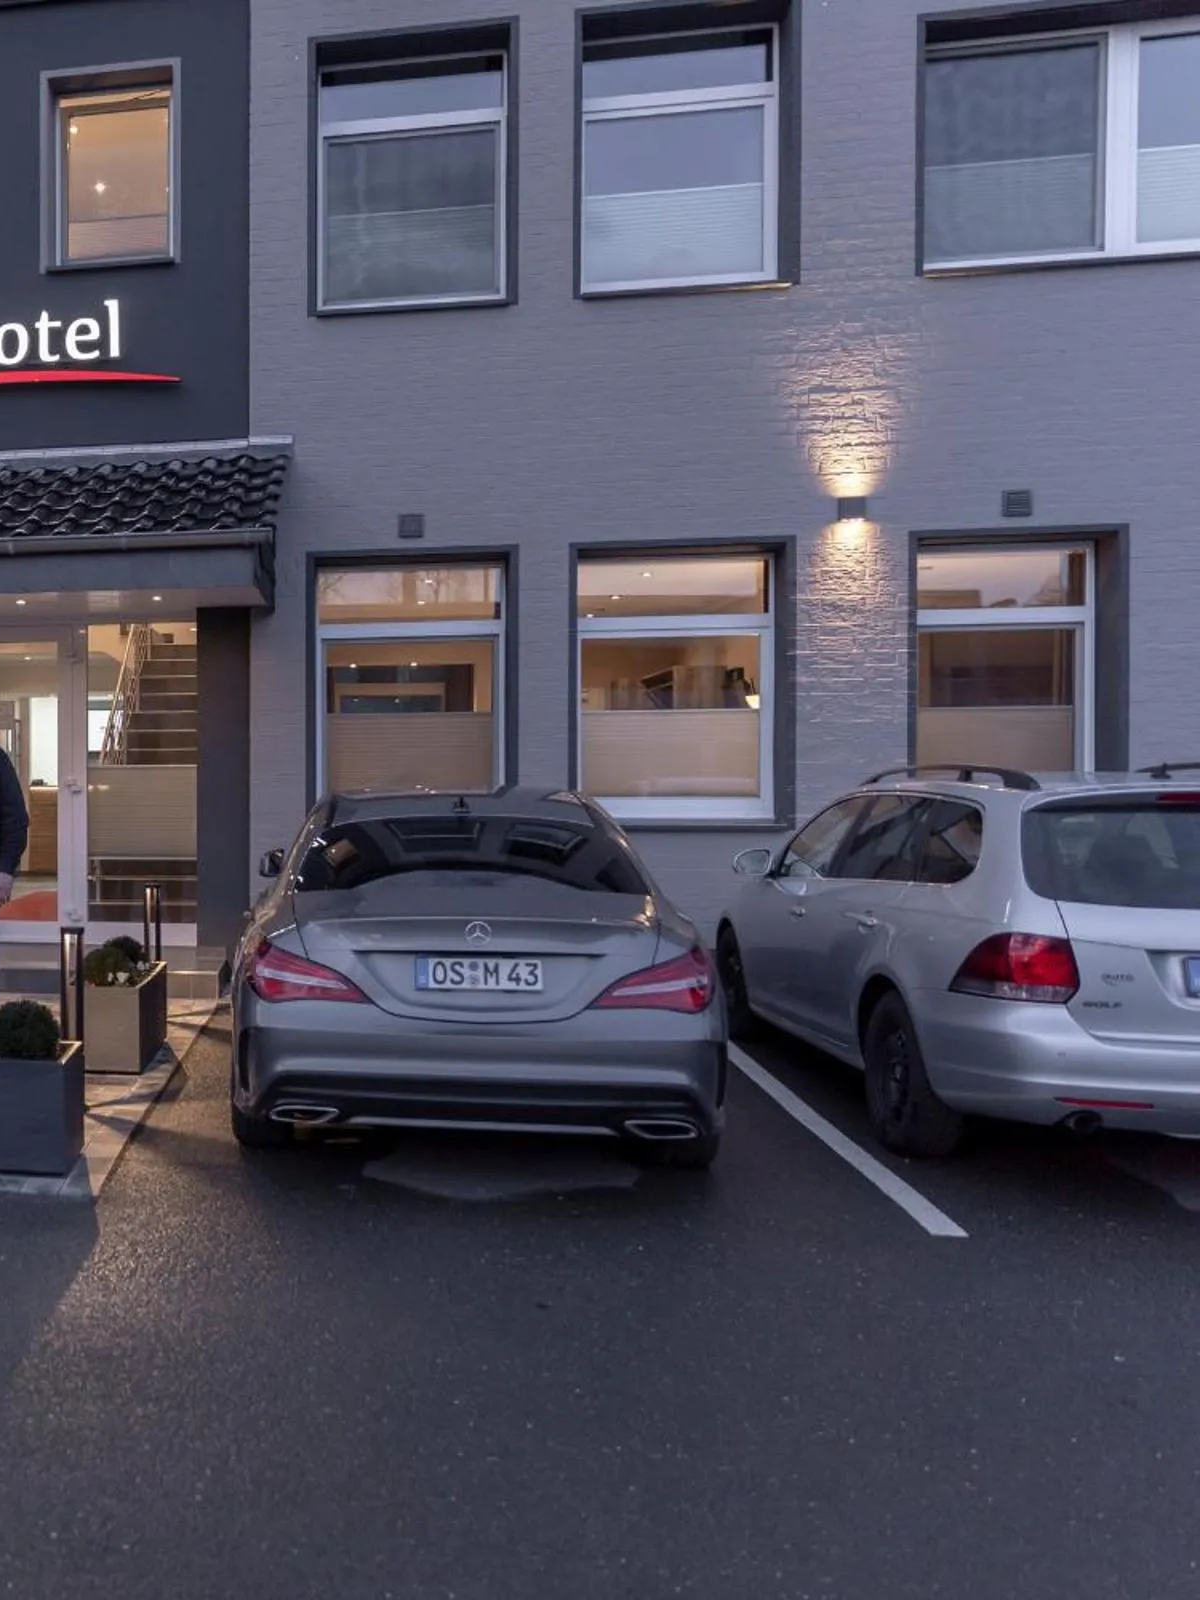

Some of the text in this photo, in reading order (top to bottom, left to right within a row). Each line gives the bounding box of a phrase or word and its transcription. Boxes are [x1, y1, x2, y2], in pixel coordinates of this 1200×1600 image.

[432, 960, 539, 987] OS M 43
